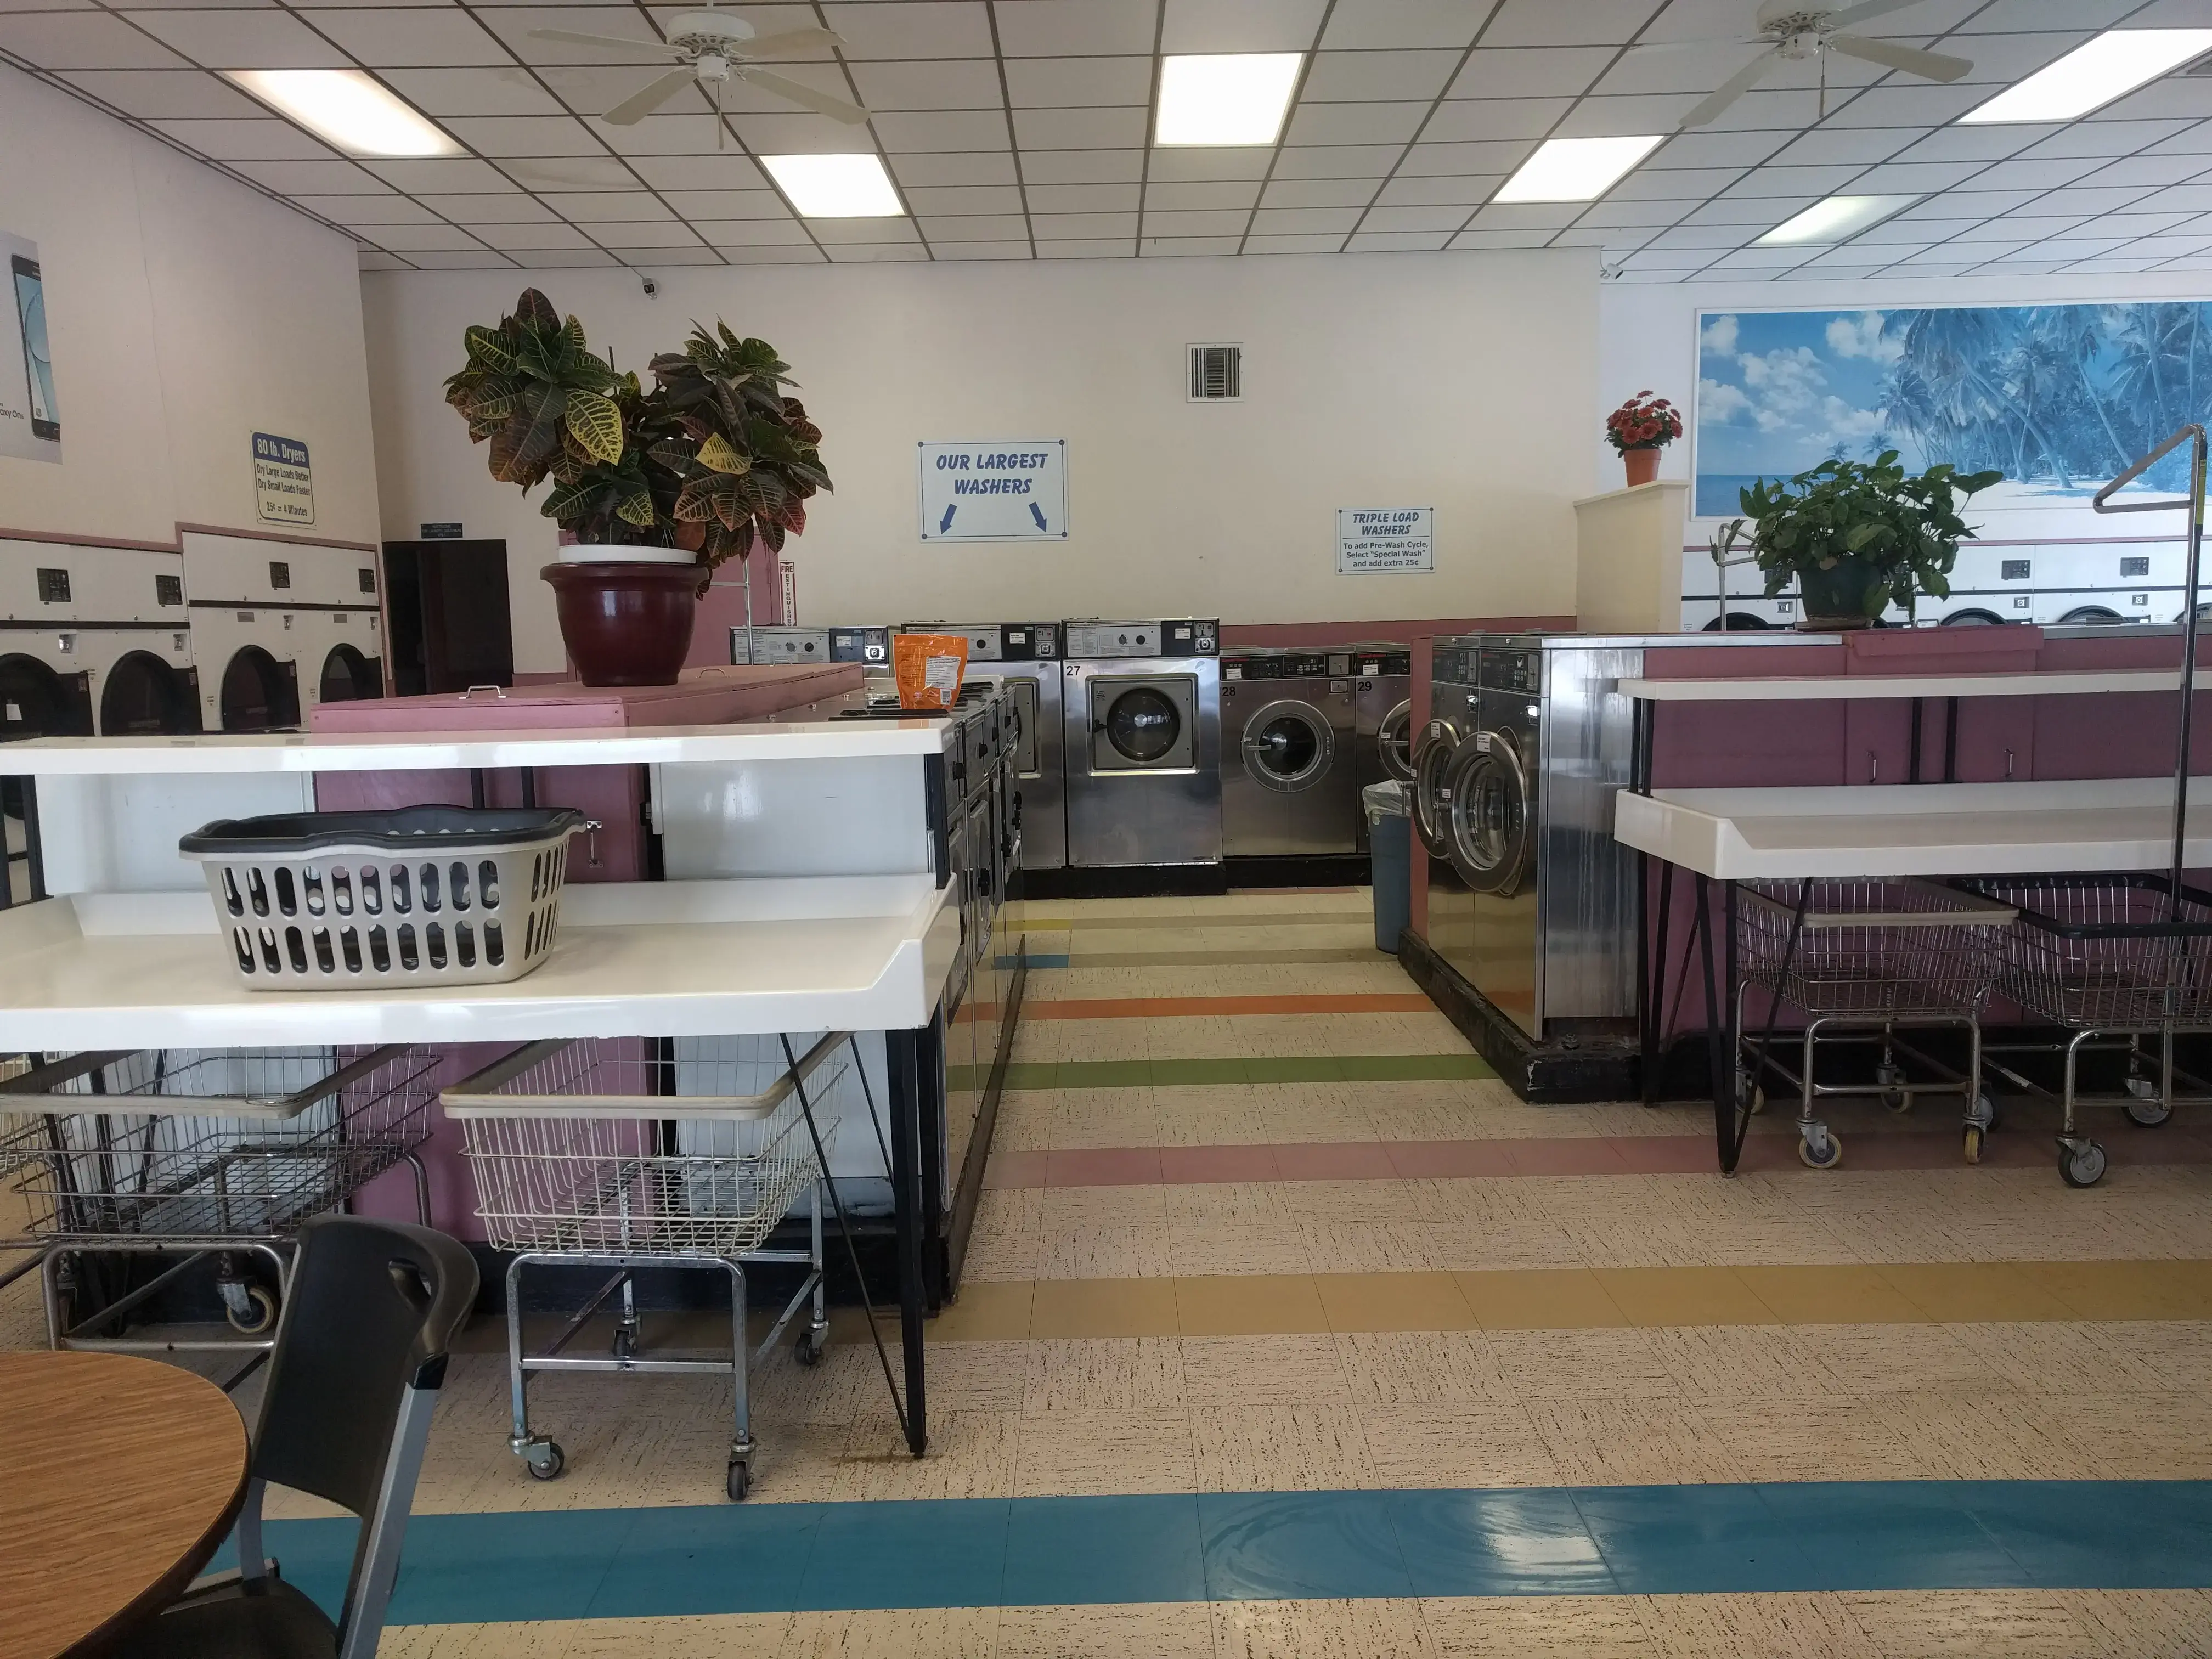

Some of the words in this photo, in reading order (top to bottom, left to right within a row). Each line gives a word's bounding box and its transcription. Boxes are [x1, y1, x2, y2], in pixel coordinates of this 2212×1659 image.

[257, 438, 268, 455] 80
[270, 441, 280, 457] lb.
[281, 443, 306, 463] Dryers
[936, 454, 970, 470] OUR
[976, 453, 1048, 470] LARGEST
[257, 463, 265, 476] Dry
[266, 465, 279, 478] Large
[280, 467, 294, 479] Loads
[295, 470, 309, 482] Better
[258, 478, 266, 491] Dry
[267, 480, 280, 491] Small
[281, 482, 295, 494] Loads
[296, 484, 310, 496] Faster
[955, 478, 1032, 495] WASHERS
[266, 501, 275, 512] 25¢
[283, 504, 287, 514] 4
[288, 505, 307, 516] Minutes
[1353, 512, 1390, 523] TRIPLE
[1392, 512, 1419, 522] LOAD
[1362, 524, 1412, 535] WASHERS
[1370, 541, 1405, 549] Pre-Wash
[1407, 541, 1429, 549] Cycle,
[1370, 550, 1400, 559] “Special
[1066, 665, 1081, 676] 27
[1222, 686, 1236, 697] 28
[1358, 681, 1372, 692] 29
